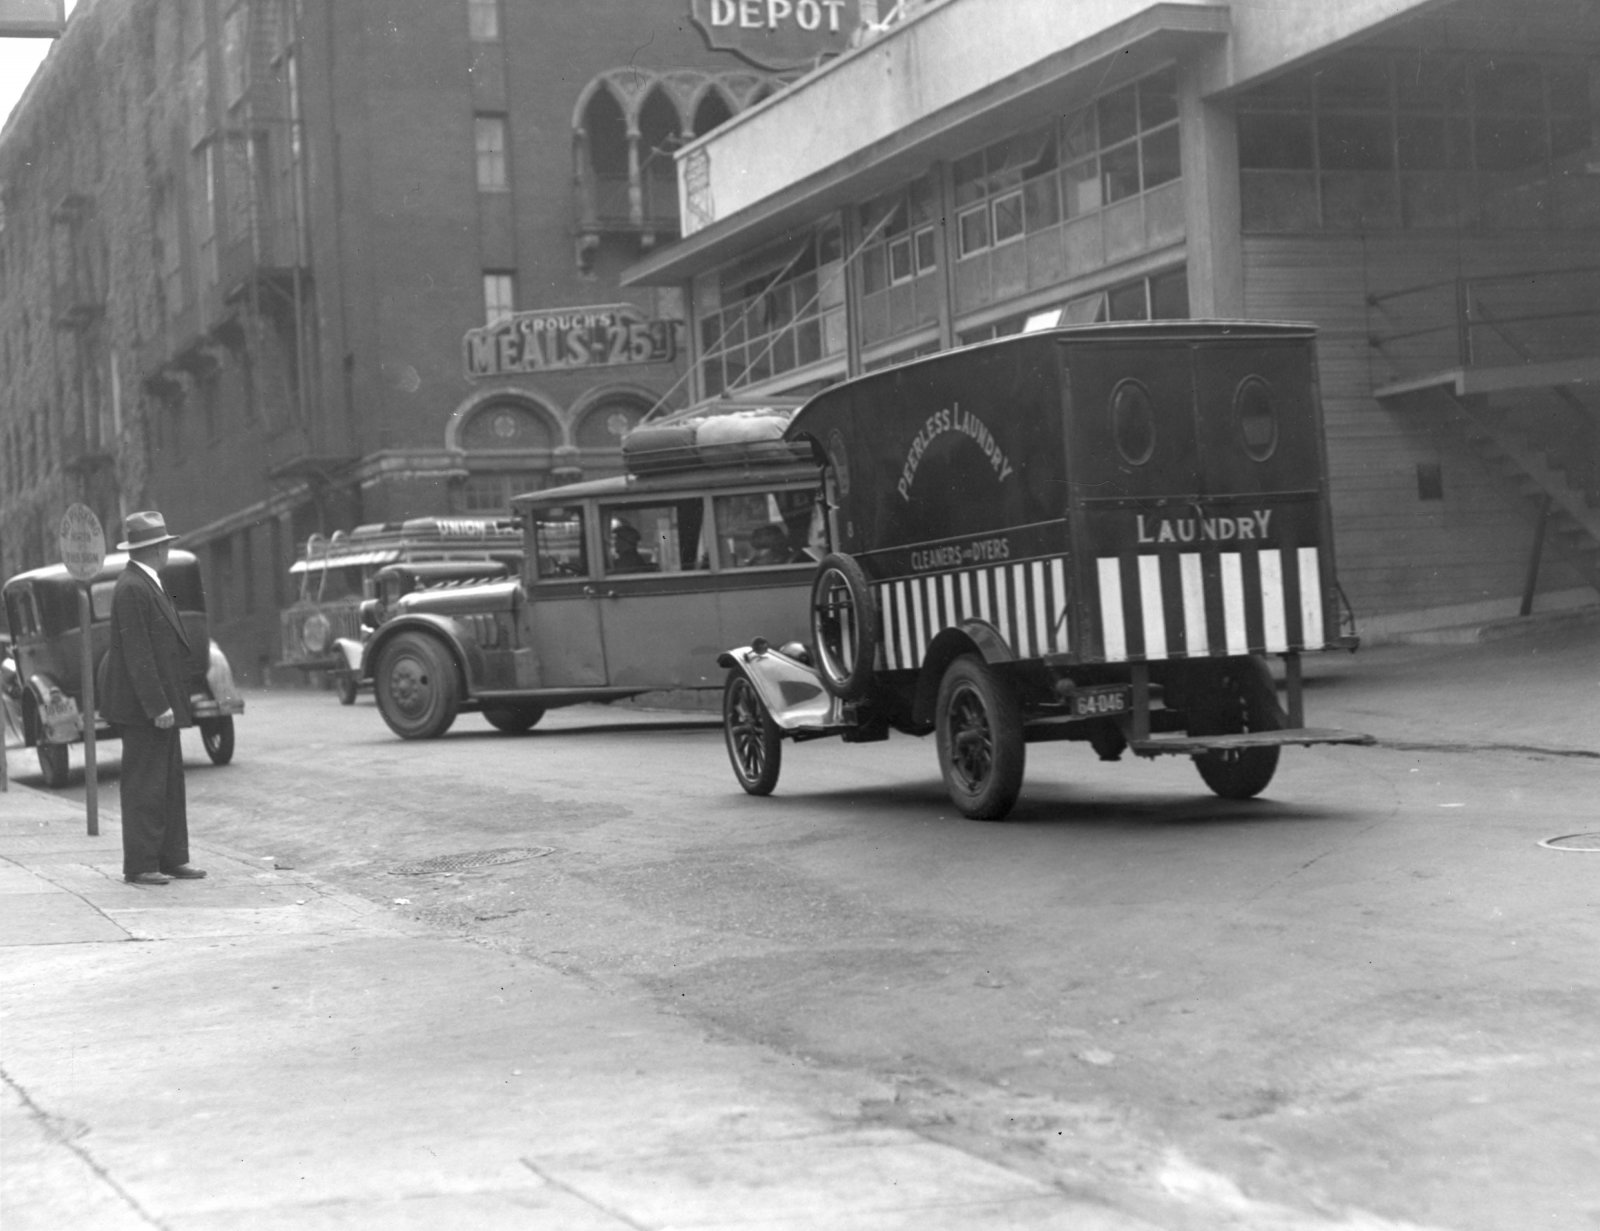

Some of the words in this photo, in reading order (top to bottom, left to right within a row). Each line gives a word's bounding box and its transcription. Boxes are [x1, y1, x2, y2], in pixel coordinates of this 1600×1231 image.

[711, 0, 845, 31] DEPOT
[520, 313, 611, 333] CROUCH'S
[897, 408, 951, 502] PEERLESS
[953, 401, 1014, 482] LAUNDRY
[436, 520, 487, 536] UNION
[1136, 509, 1273, 543] LAUNDRY
[911, 545, 962, 571] CLEANERS
[972, 538, 1010, 561] DYERS
